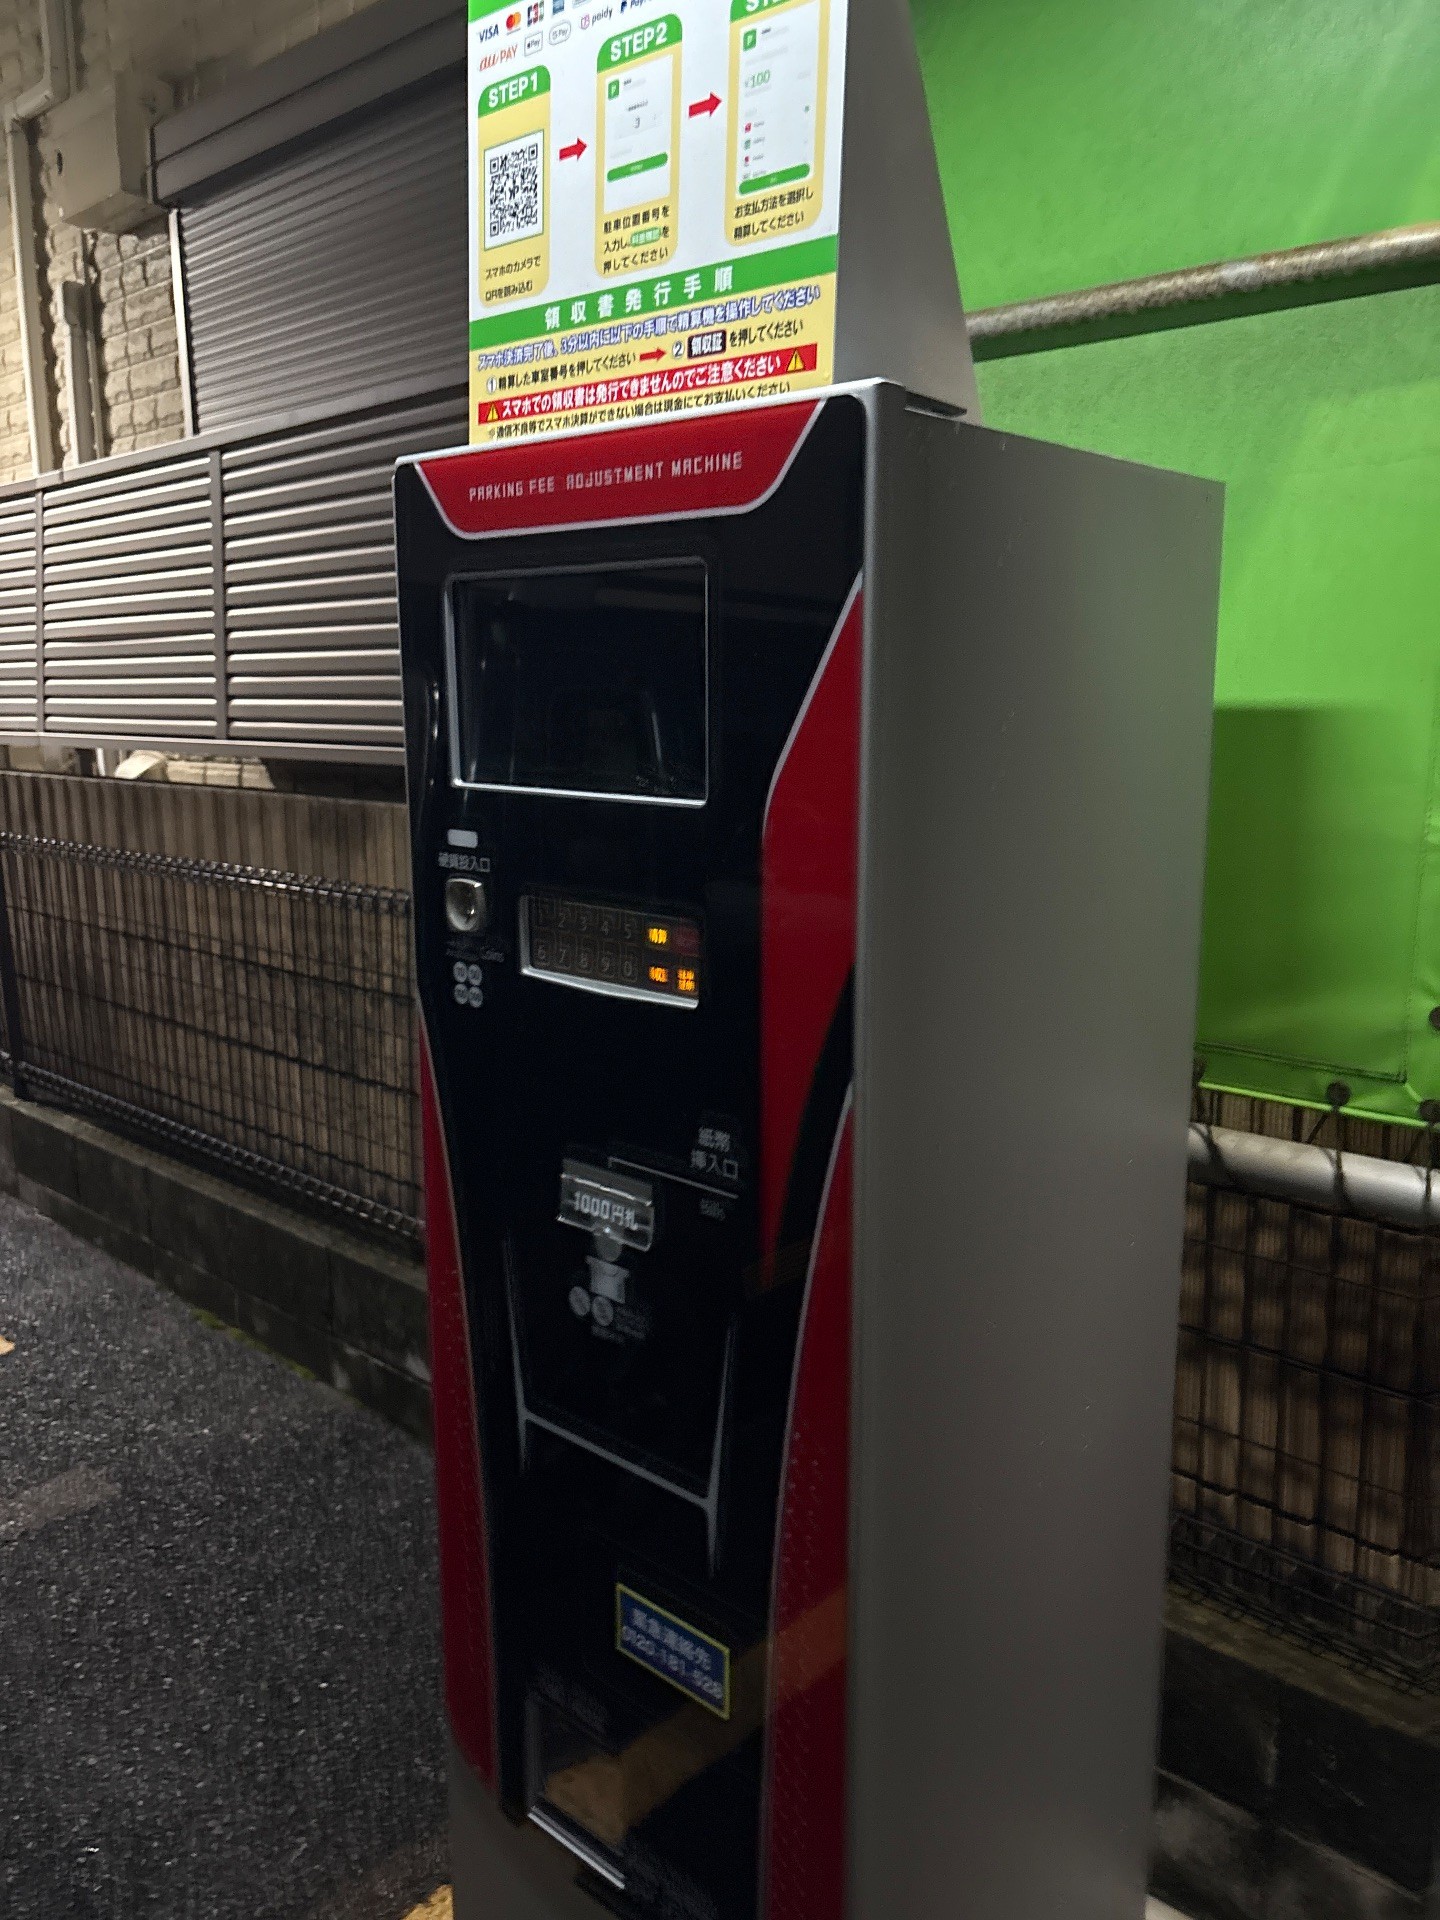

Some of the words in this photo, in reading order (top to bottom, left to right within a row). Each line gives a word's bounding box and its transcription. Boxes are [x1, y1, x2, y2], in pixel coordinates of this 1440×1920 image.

[479, 24, 499, 43] VISA
[610, 22, 668, 62] STEP2
[488, 72, 538, 108] STEP1
[485, 255, 541, 280] スマホのカメラで
[603, 246, 668, 274] 押してください
[545, 266, 733, 330] 領収書発行手順
[729, 319, 803, 348] を押してください
[502, 355, 781, 418] スマホでの領収書は発行できませんのでご注意ください
[469, 480, 523, 502] PARKING
[529, 476, 555, 495] FEE
[566, 461, 664, 491] ADJUSTMENT
[671, 450, 743, 478] MACHINE
